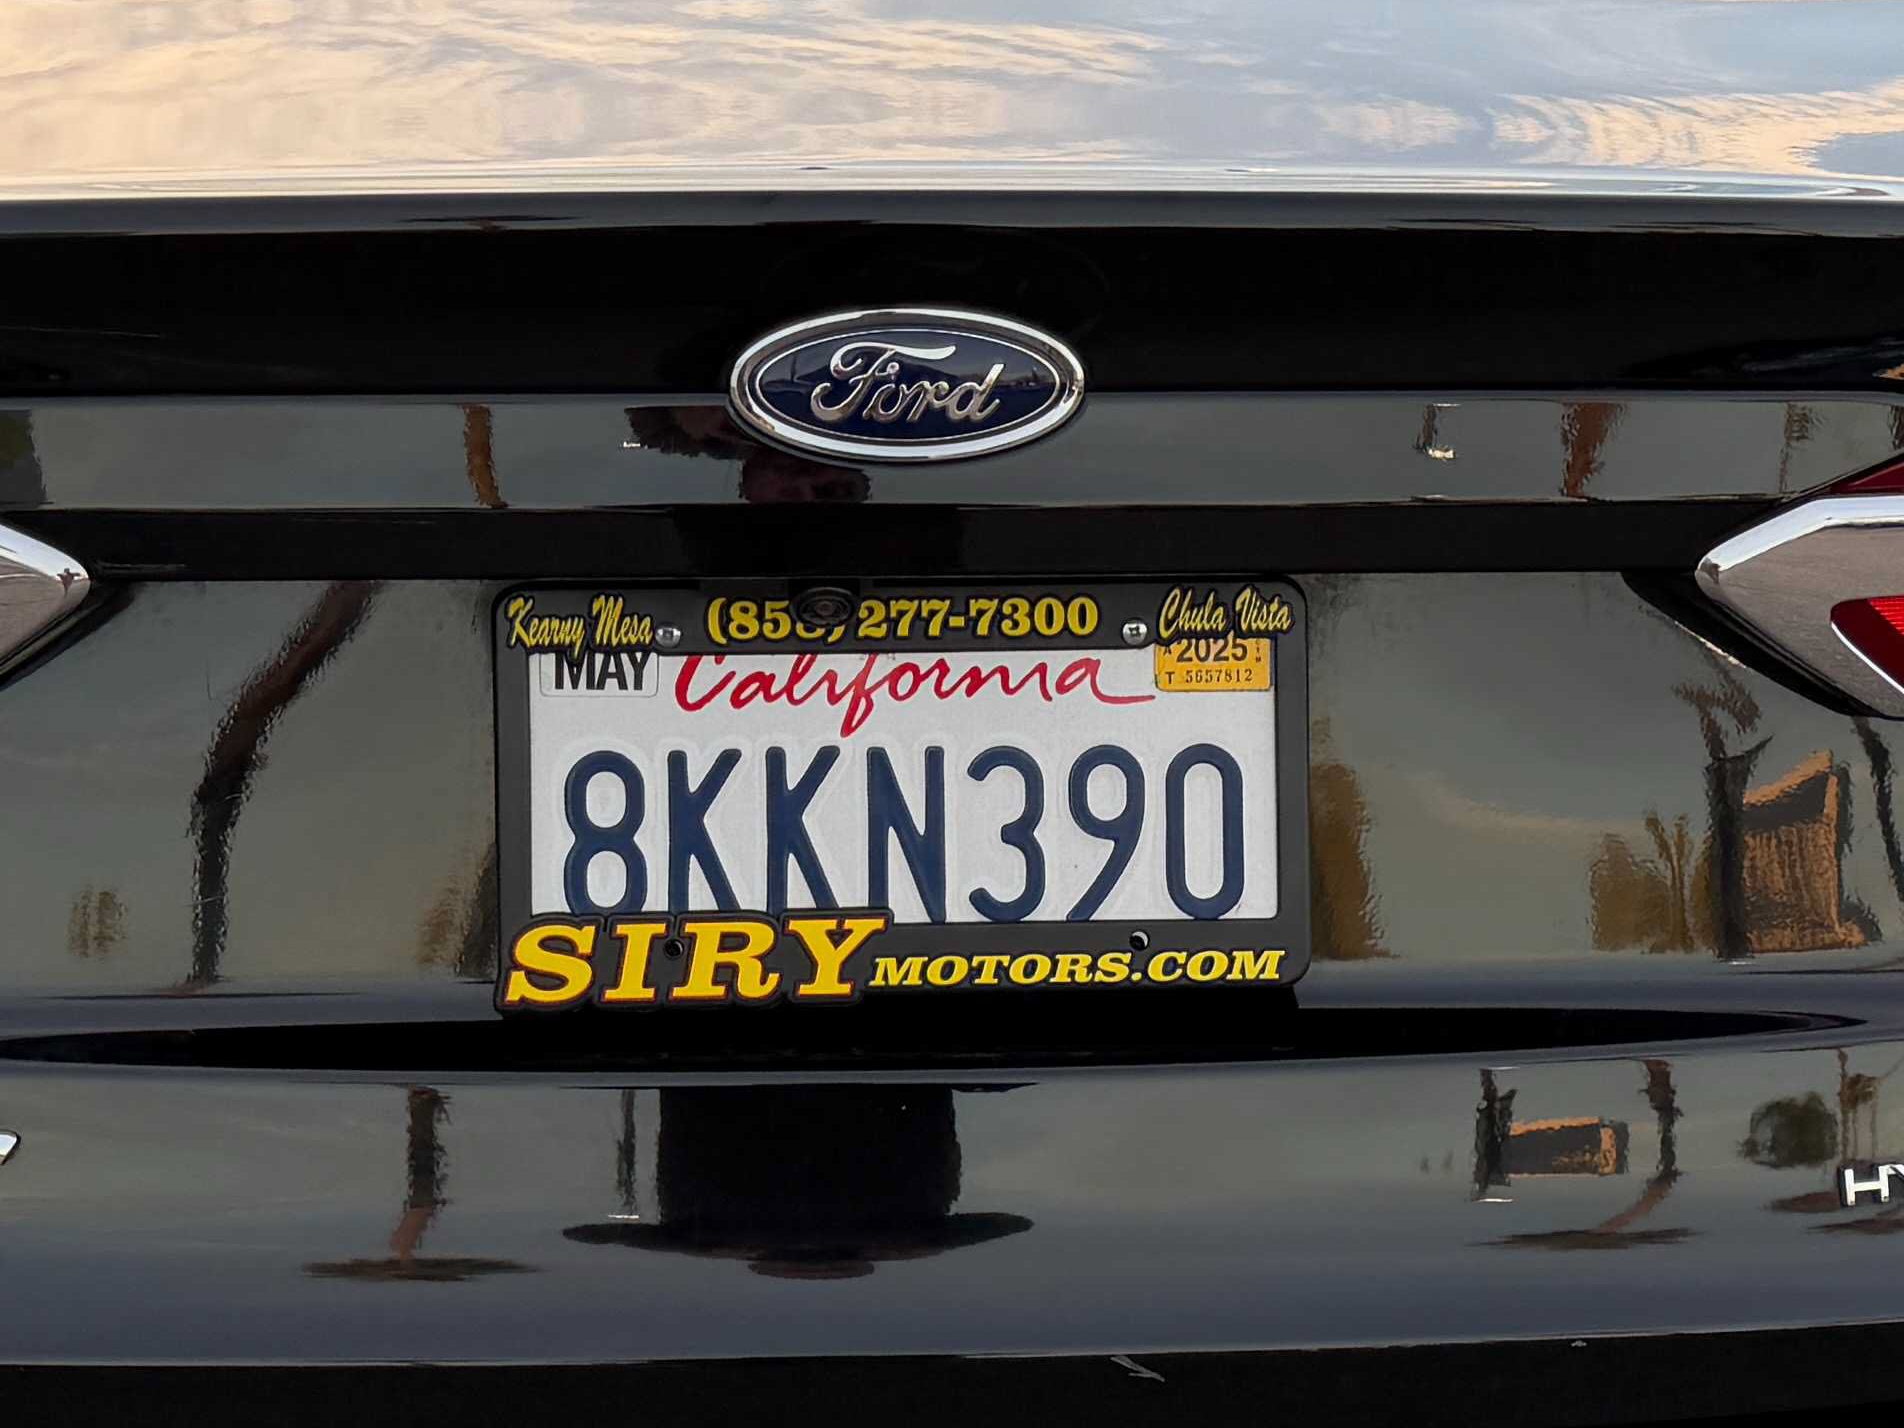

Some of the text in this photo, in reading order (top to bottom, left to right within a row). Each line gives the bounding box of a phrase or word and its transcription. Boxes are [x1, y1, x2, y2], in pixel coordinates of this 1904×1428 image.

[810, 341, 1005, 423] Ford
[507, 594, 654, 660] Kearny Mesa
[857, 596, 1098, 639] 277-7300
[1158, 586, 1293, 639] Chula Vista
[553, 652, 651, 691] MAY
[1177, 638, 1248, 663] 2025
[674, 652, 1156, 738] California
[562, 743, 1246, 922] 8KKN390
[504, 916, 1287, 1006] SIRY MOTORS.COM
